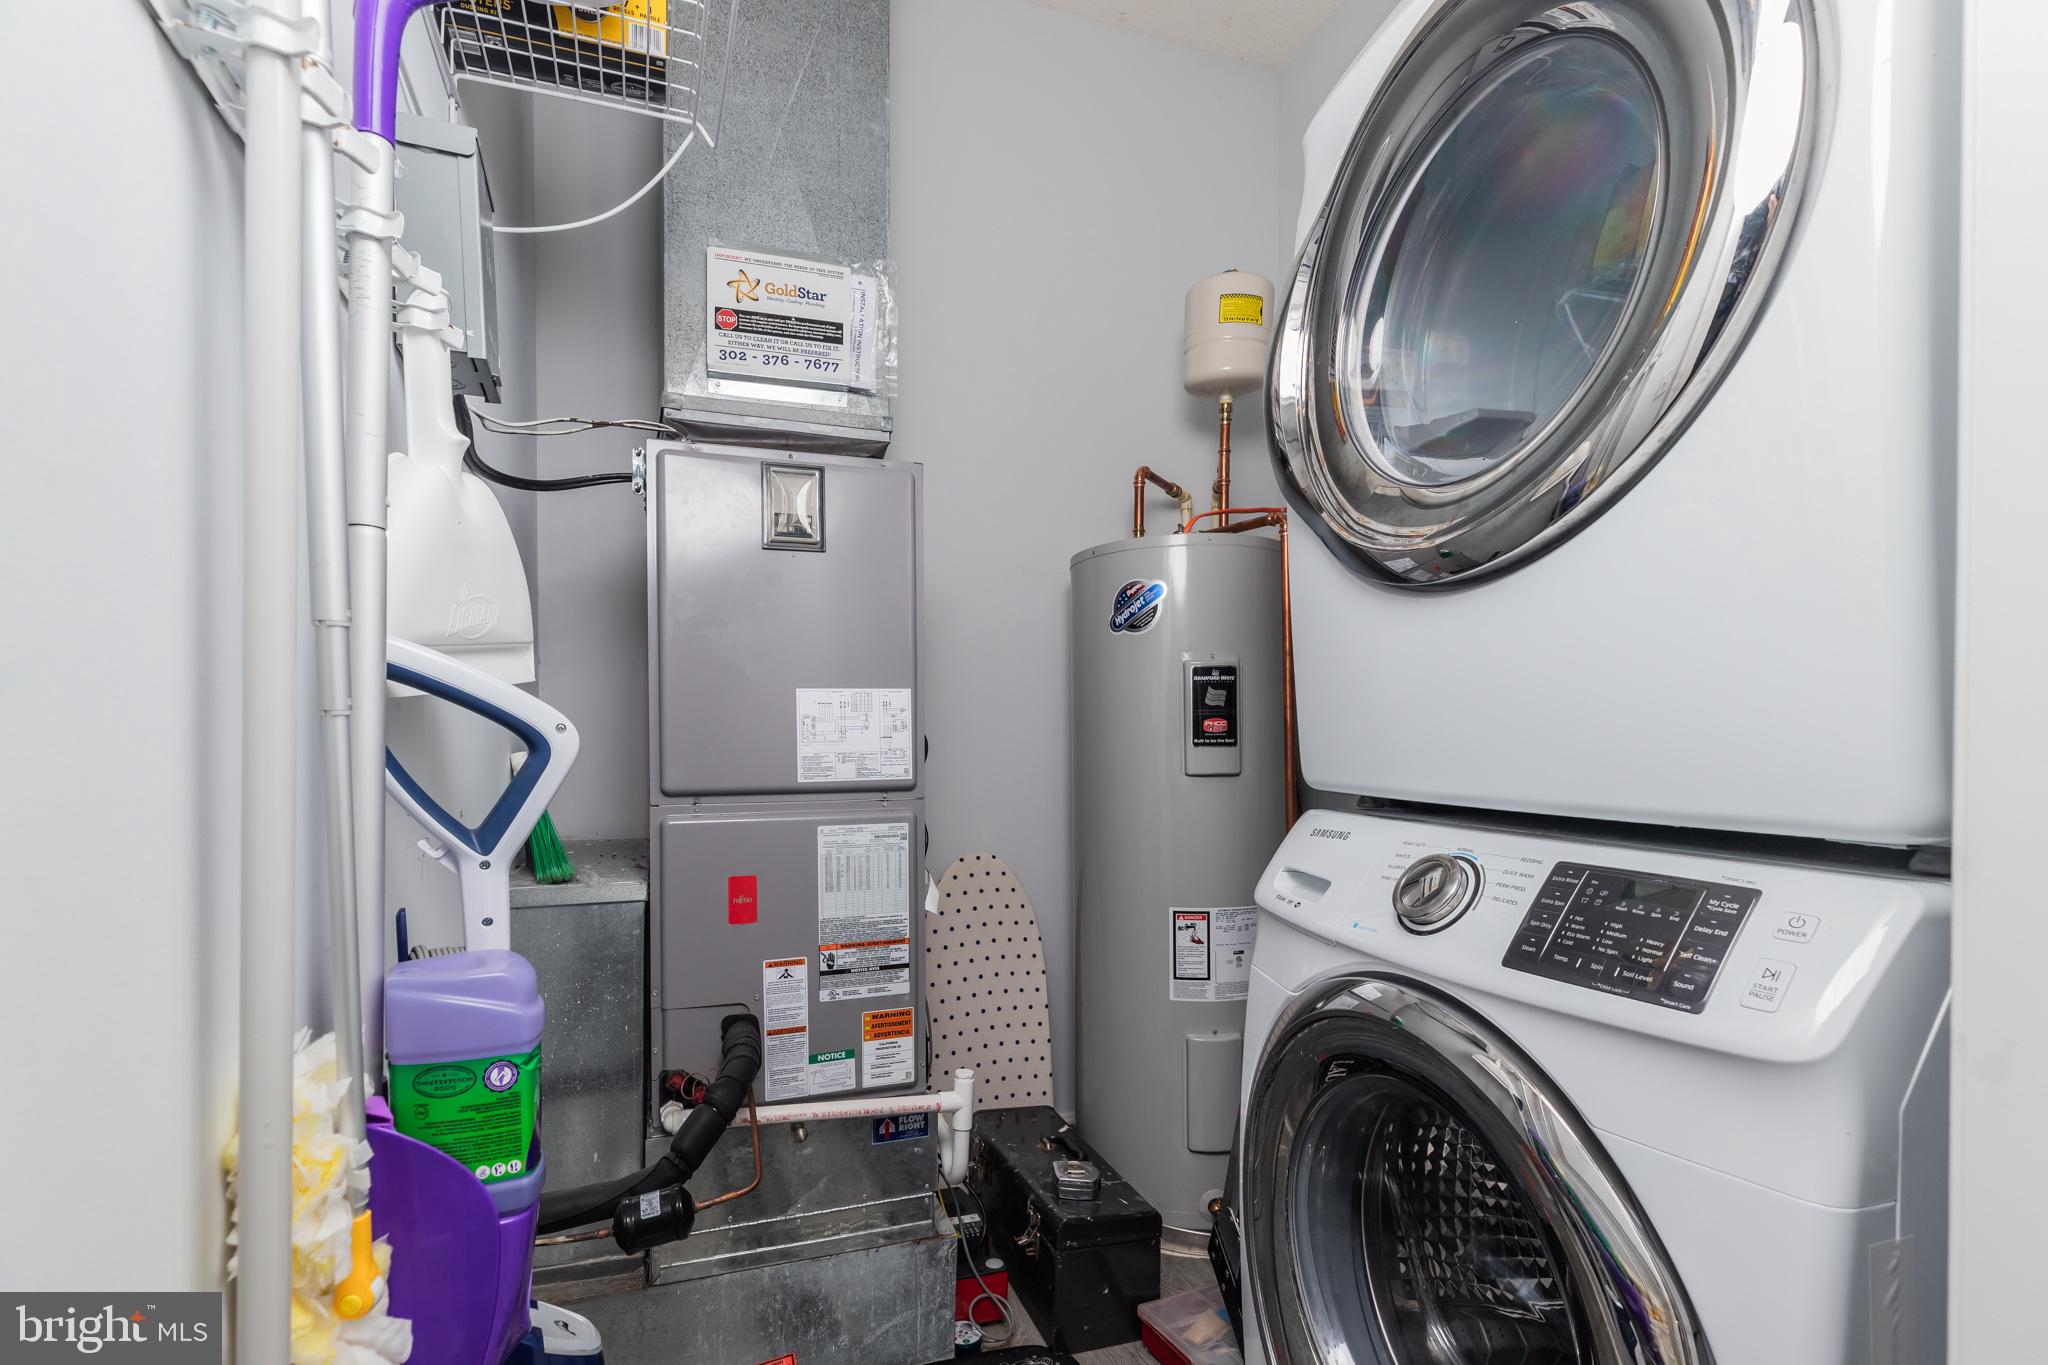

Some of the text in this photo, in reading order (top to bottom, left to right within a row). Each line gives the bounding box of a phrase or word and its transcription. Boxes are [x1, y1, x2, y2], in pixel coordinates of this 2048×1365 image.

[765, 282, 827, 302] GoldStar
[717, 315, 737, 324] STOP
[753, 335, 773, 343] CLEAN
[789, 339, 804, 347] CALL
[823, 343, 832, 351] FIX
[728, 339, 750, 348] EITHER
[777, 345, 792, 353] WILL
[800, 348, 832, 357] PREPARED!
[719, 349, 747, 361] 302
[762, 354, 789, 366] 376
[804, 359, 840, 373] 7677
[1115, 596, 1145, 626] Hydrojet
[1310, 828, 1351, 841] SAMSUNG
[1520, 857, 1544, 865] BEDDING
[1519, 871, 1535, 879] WASH
[1510, 884, 1526, 893] PRESS
[1492, 896, 1519, 906] DELICATES
[1554, 899, 1565, 907] Spin
[1709, 899, 1740, 910] My Cycle
[1541, 921, 1553, 930] Only
[1606, 930, 1628, 939] Medium
[1694, 925, 1729, 937] Delay End
[1777, 928, 1807, 938] POWER
[1576, 933, 1591, 941] Warm
[1646, 939, 1665, 948] Heavy
[1521, 944, 1537, 953] Steam
[1642, 947, 1664, 956] Normal
[1554, 954, 1569, 963] Temp
[1638, 955, 1653, 964] Light
[1679, 951, 1693, 959] Self
[772, 959, 804, 968] WARNING
[1590, 963, 1604, 971] Spin
[1622, 970, 1654, 983] Soil Level
[1673, 980, 1695, 991] Sound
[1753, 983, 1778, 993] START
[1749, 990, 1775, 1001] PAUSE
[1679, 1002, 1692, 1010] Care
[872, 1010, 911, 1020] WARNING
[871, 1020, 911, 1029] AVERTISSEMENT
[873, 1029, 910, 1038] ADVERTENCIA
[817, 1051, 846, 1061] NOTICE
[416, 1077, 473, 1087] HOUSEKEEPING
[899, 1113, 925, 1124] FLOW
[899, 1121, 926, 1132] RIGHT
